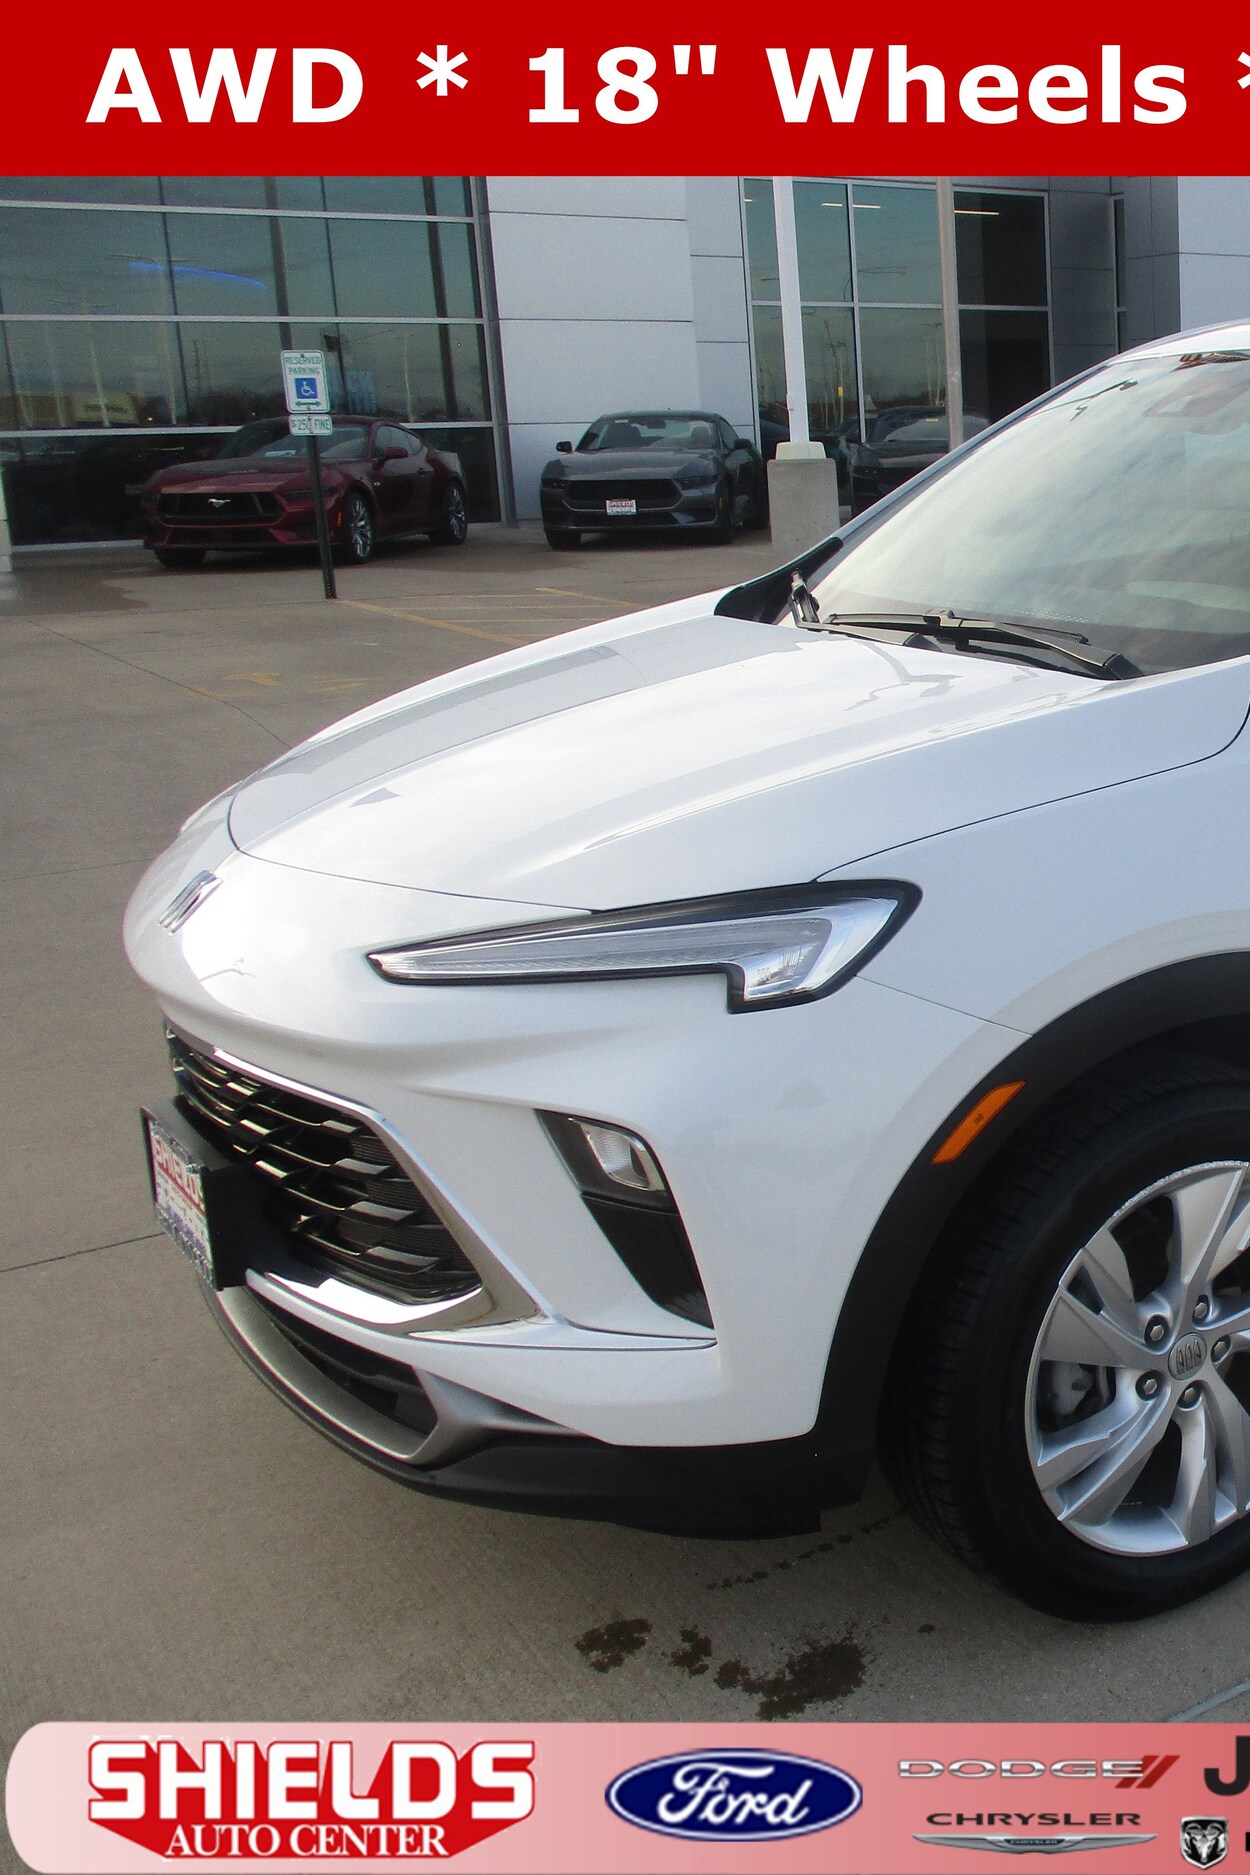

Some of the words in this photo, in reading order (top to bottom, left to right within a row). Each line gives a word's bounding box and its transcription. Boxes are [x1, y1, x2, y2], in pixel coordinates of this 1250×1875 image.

[285, 356, 321, 365] RESERVED
[288, 367, 321, 376] PARKING
[315, 419, 331, 431] FINE
